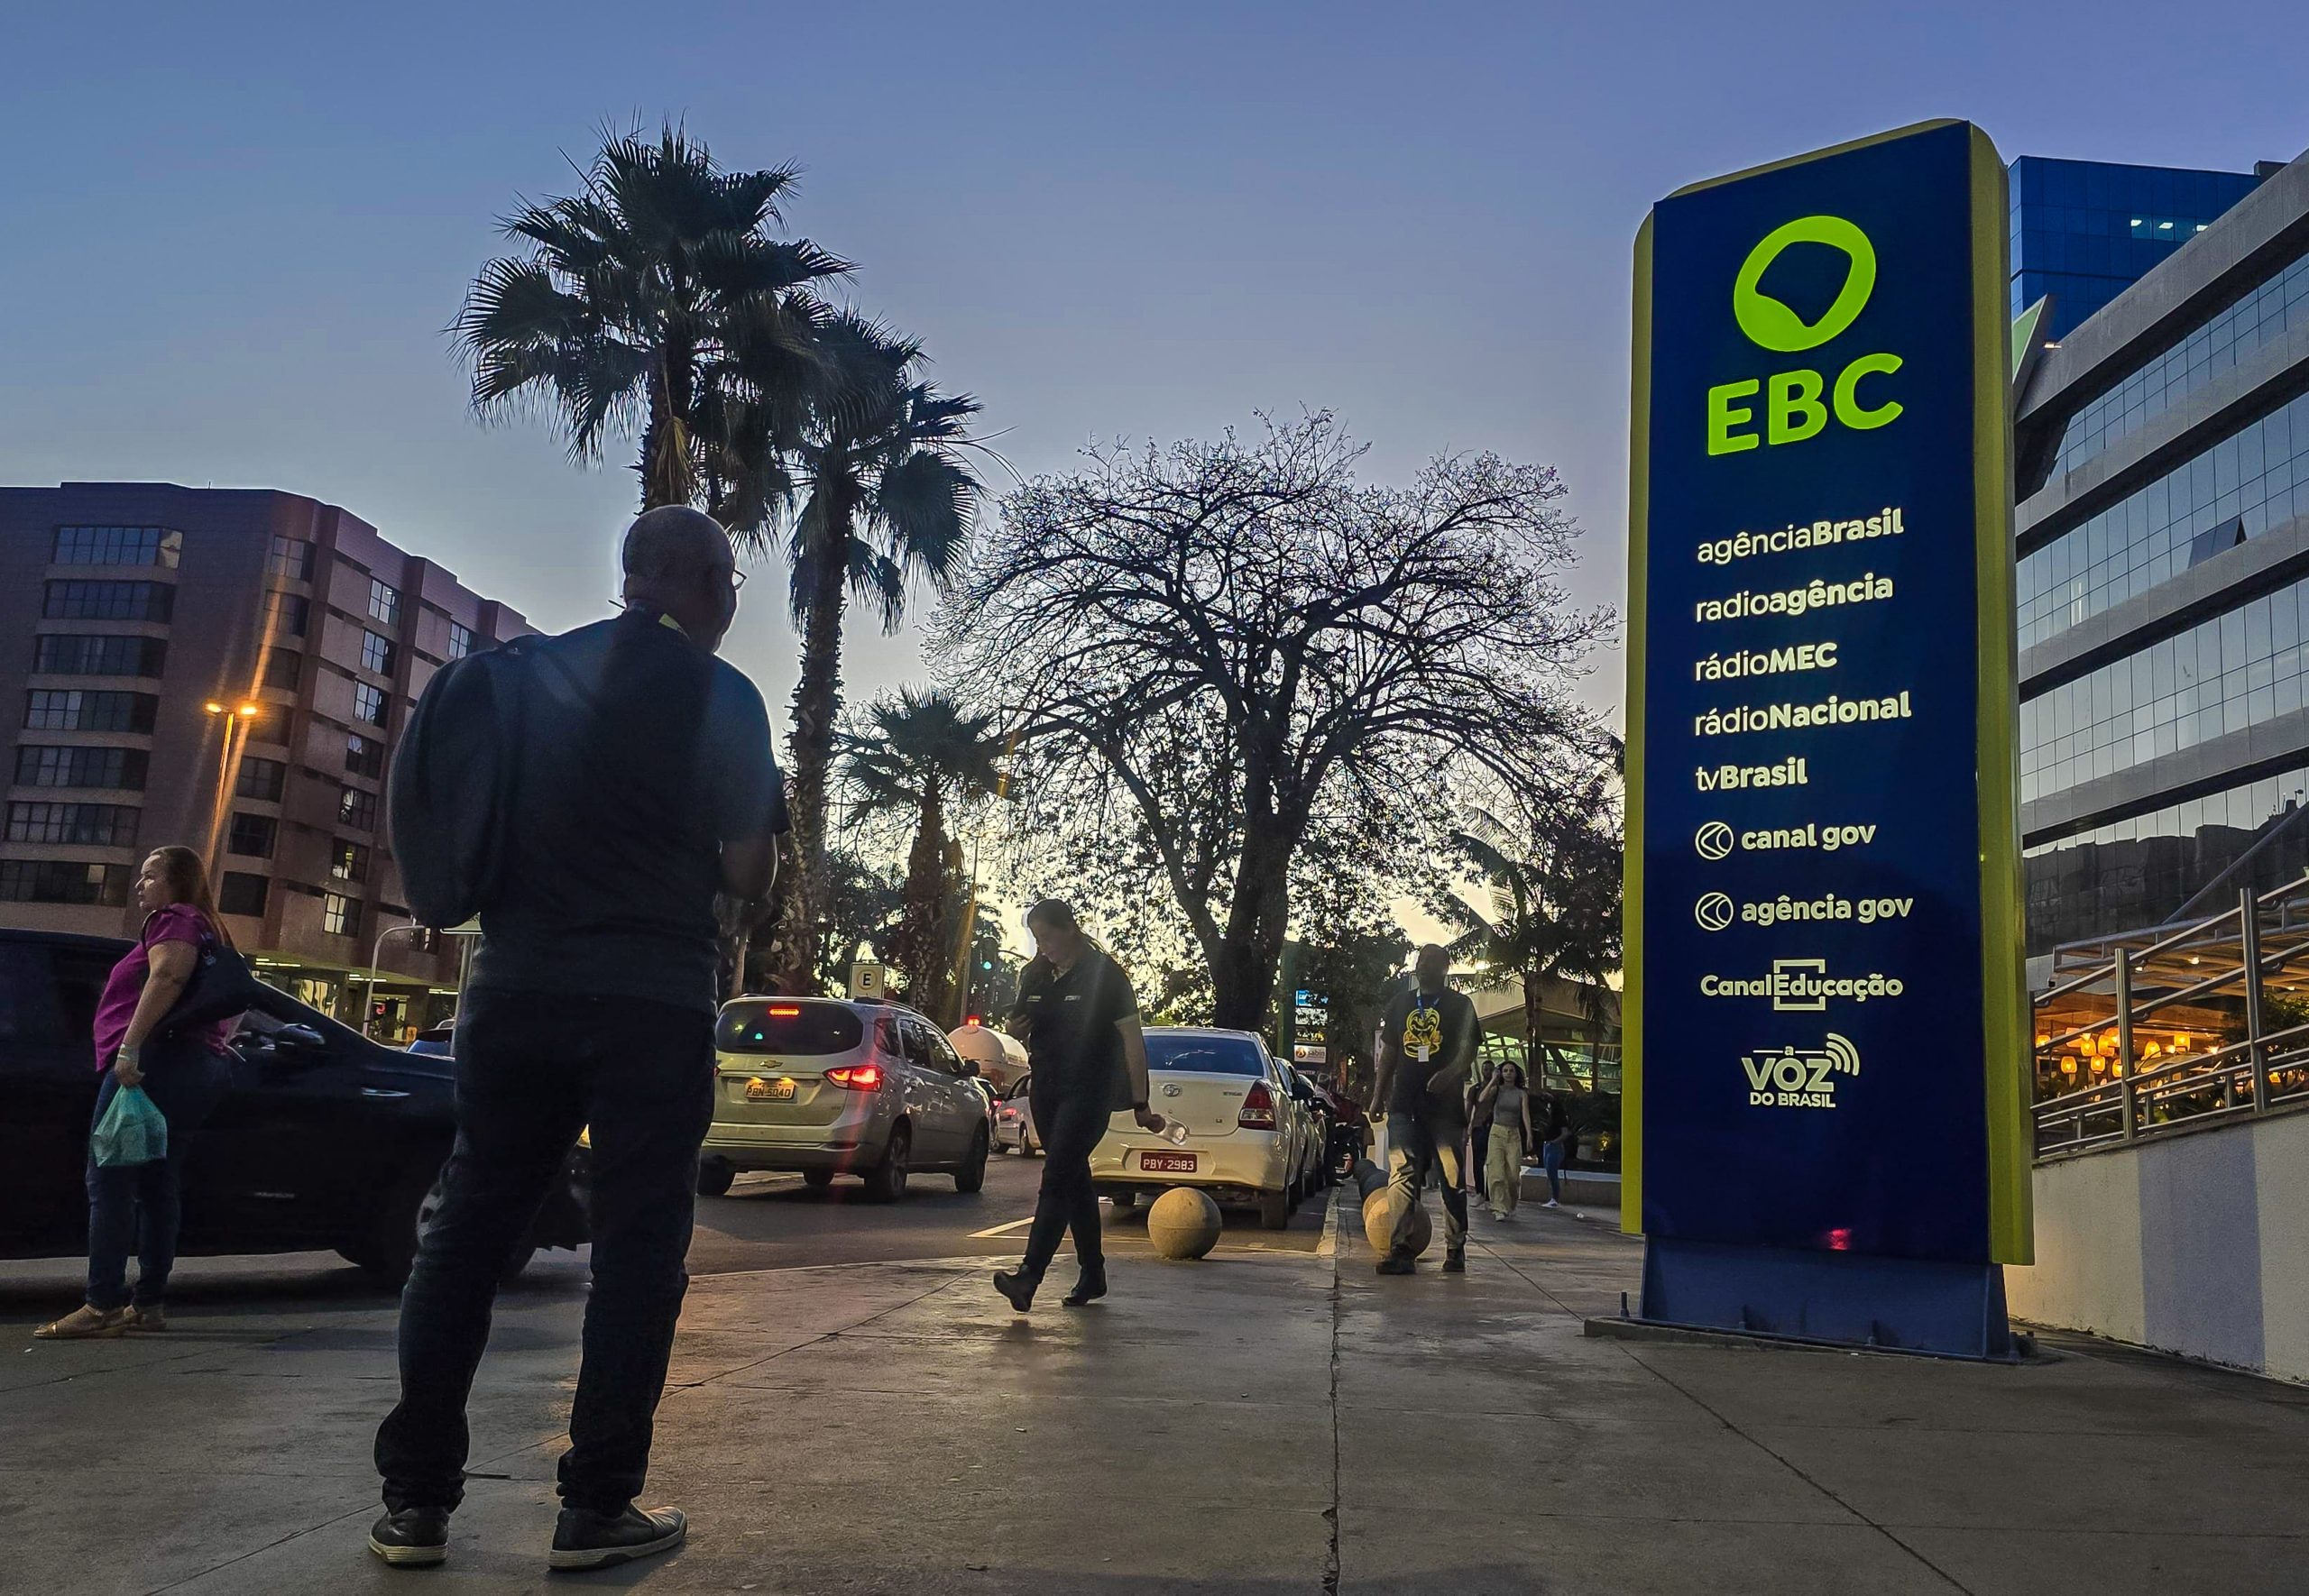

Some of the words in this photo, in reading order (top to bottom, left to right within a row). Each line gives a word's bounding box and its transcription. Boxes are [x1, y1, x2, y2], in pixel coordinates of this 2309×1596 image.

[1707, 353, 1904, 456] EBC
[1697, 507, 1905, 565] agênciaBrasil
[1696, 572, 1894, 623] radioagência
[1696, 642, 1838, 682] rádioMEC
[1695, 690, 1912, 737] rádioNacional
[1696, 756, 1808, 792] tvBrasil
[1741, 823, 1817, 850] canal
[1822, 824, 1877, 852] gov
[1741, 893, 1852, 926] agência
[1858, 897, 1914, 924] gov
[863, 973, 872, 986] E
[1784, 1045, 1794, 1056] a
[1741, 1057, 1835, 1093] VOZ
[1750, 1092, 1775, 1106] DO
[1778, 1092, 1836, 1108] BRASIL
